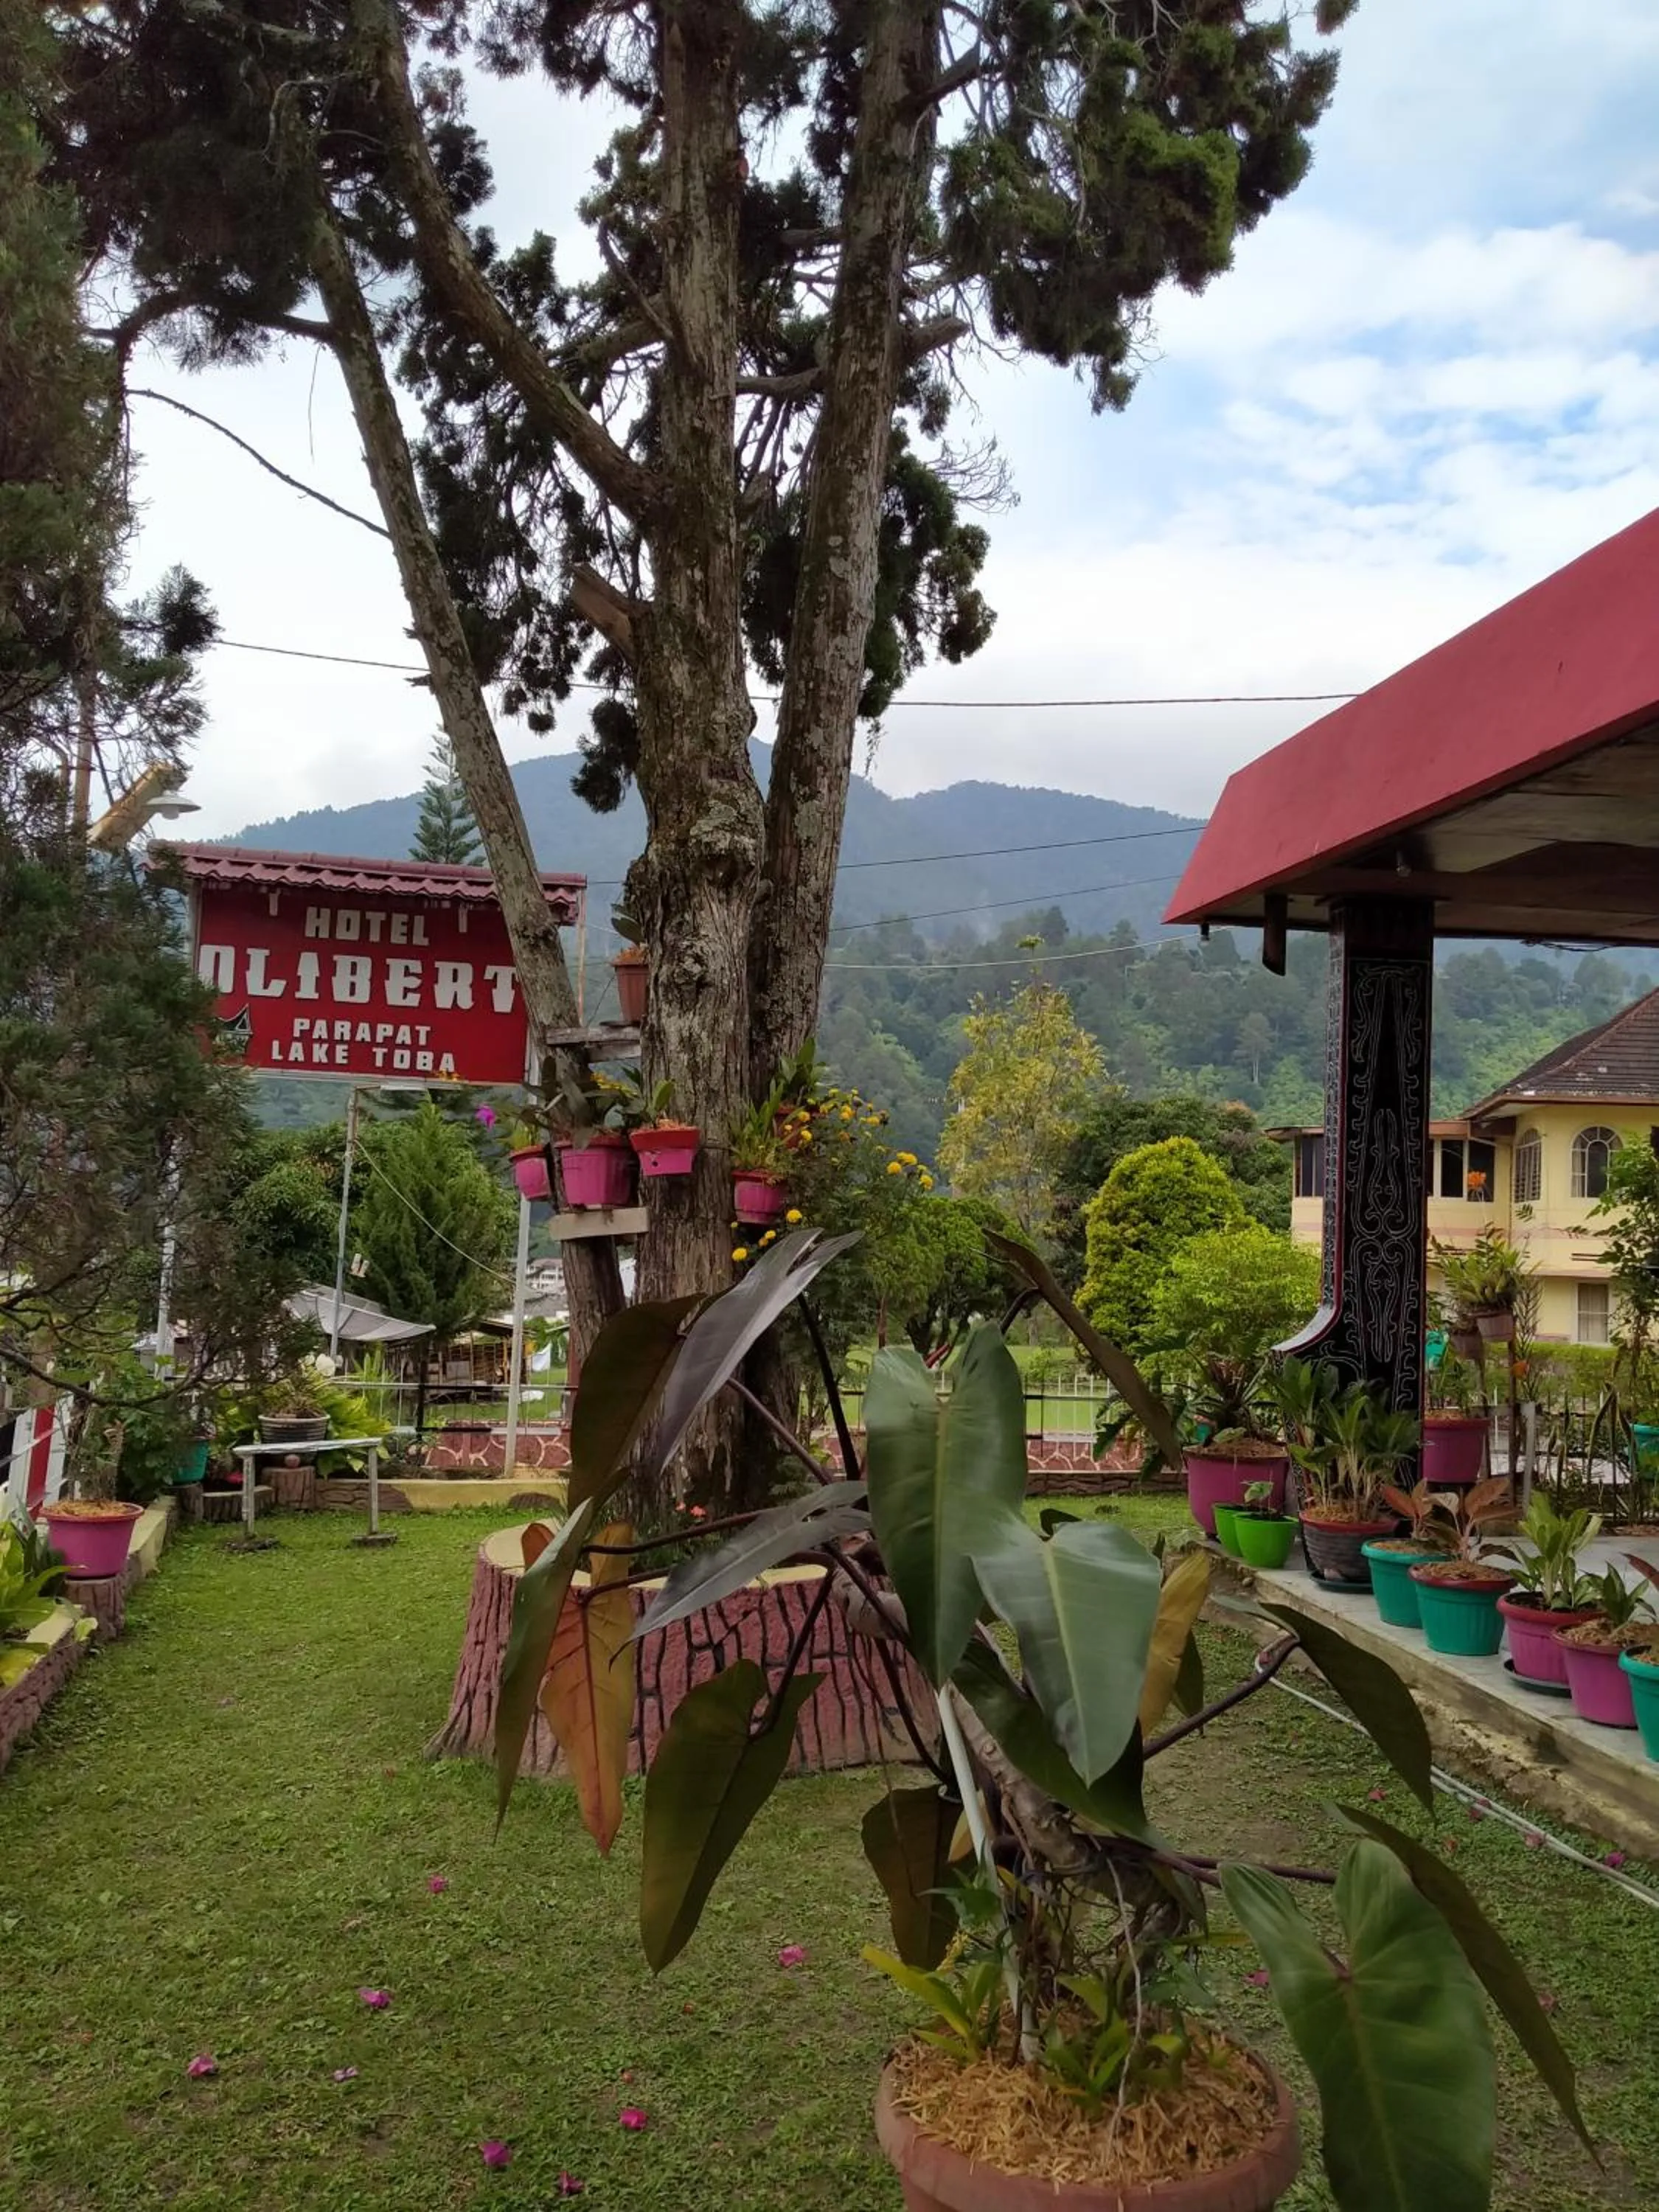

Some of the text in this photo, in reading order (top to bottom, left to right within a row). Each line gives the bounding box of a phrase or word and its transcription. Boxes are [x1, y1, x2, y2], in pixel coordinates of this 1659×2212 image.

[305, 906, 430, 946] HOTEL
[198, 944, 518, 1013] OLIBERT
[293, 1016, 431, 1046] PARAPAT
[271, 1040, 455, 1073] LAKE TOBA
